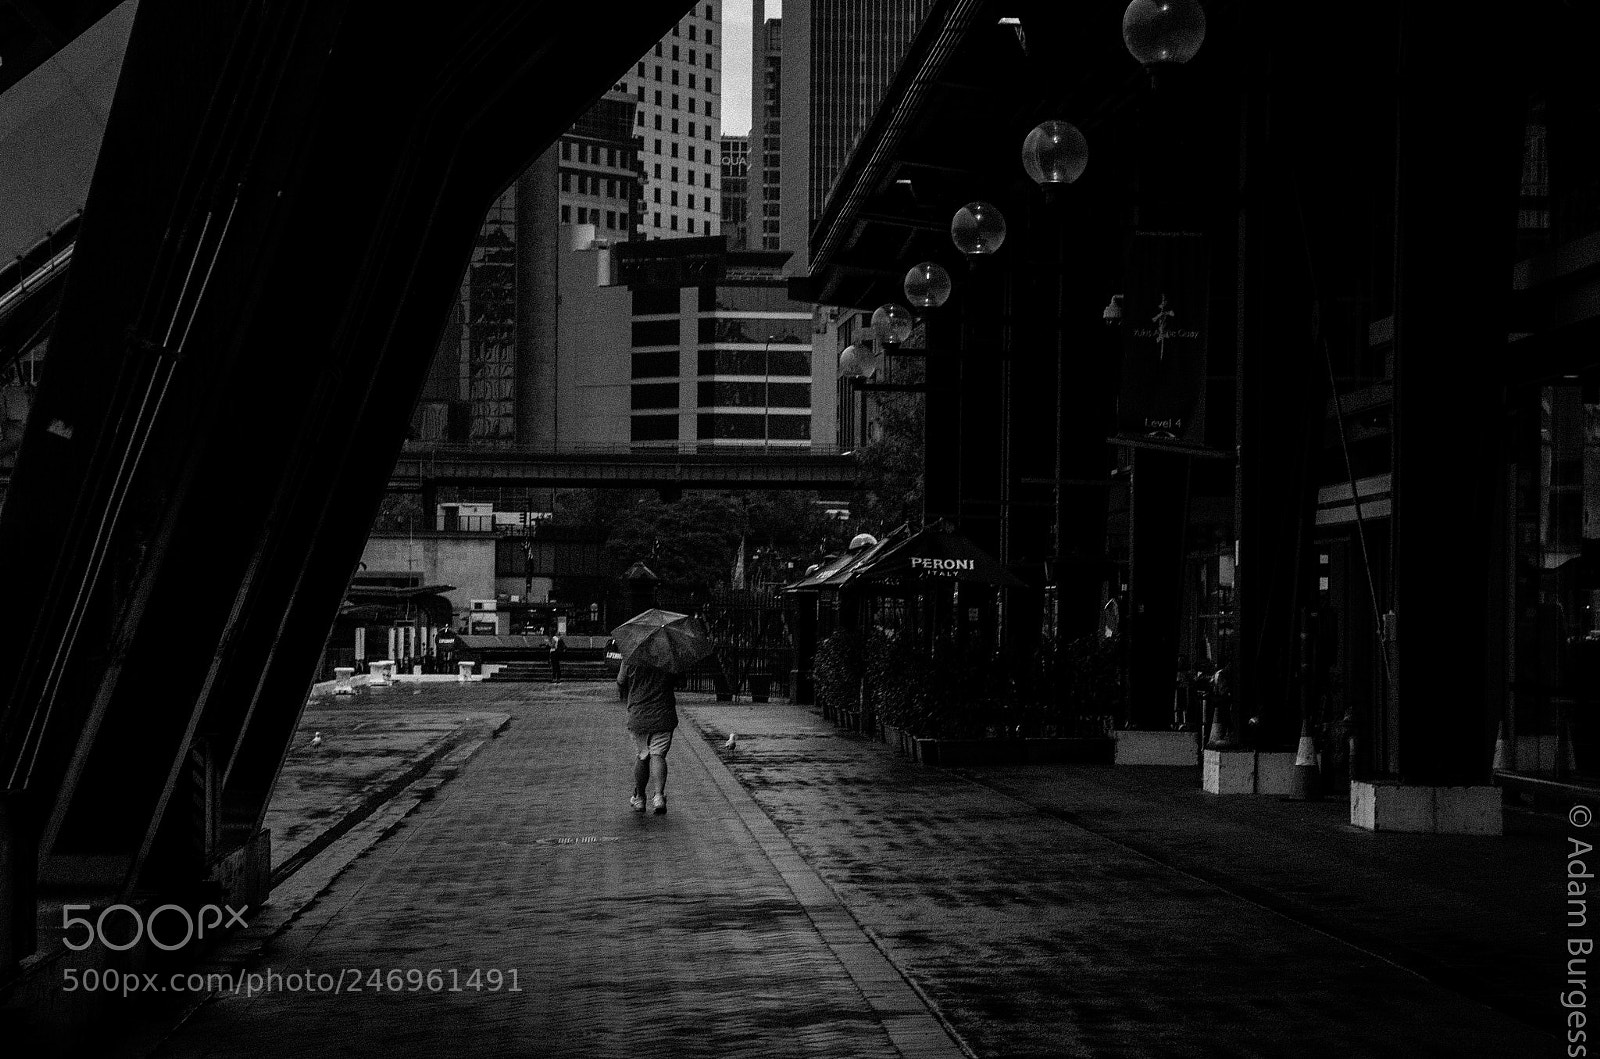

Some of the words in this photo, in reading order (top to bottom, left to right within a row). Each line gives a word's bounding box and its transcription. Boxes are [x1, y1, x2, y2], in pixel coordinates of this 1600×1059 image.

[1144, 416, 1172, 429] Level
[1175, 418, 1181, 429] 4
[911, 556, 975, 571] PERONI
